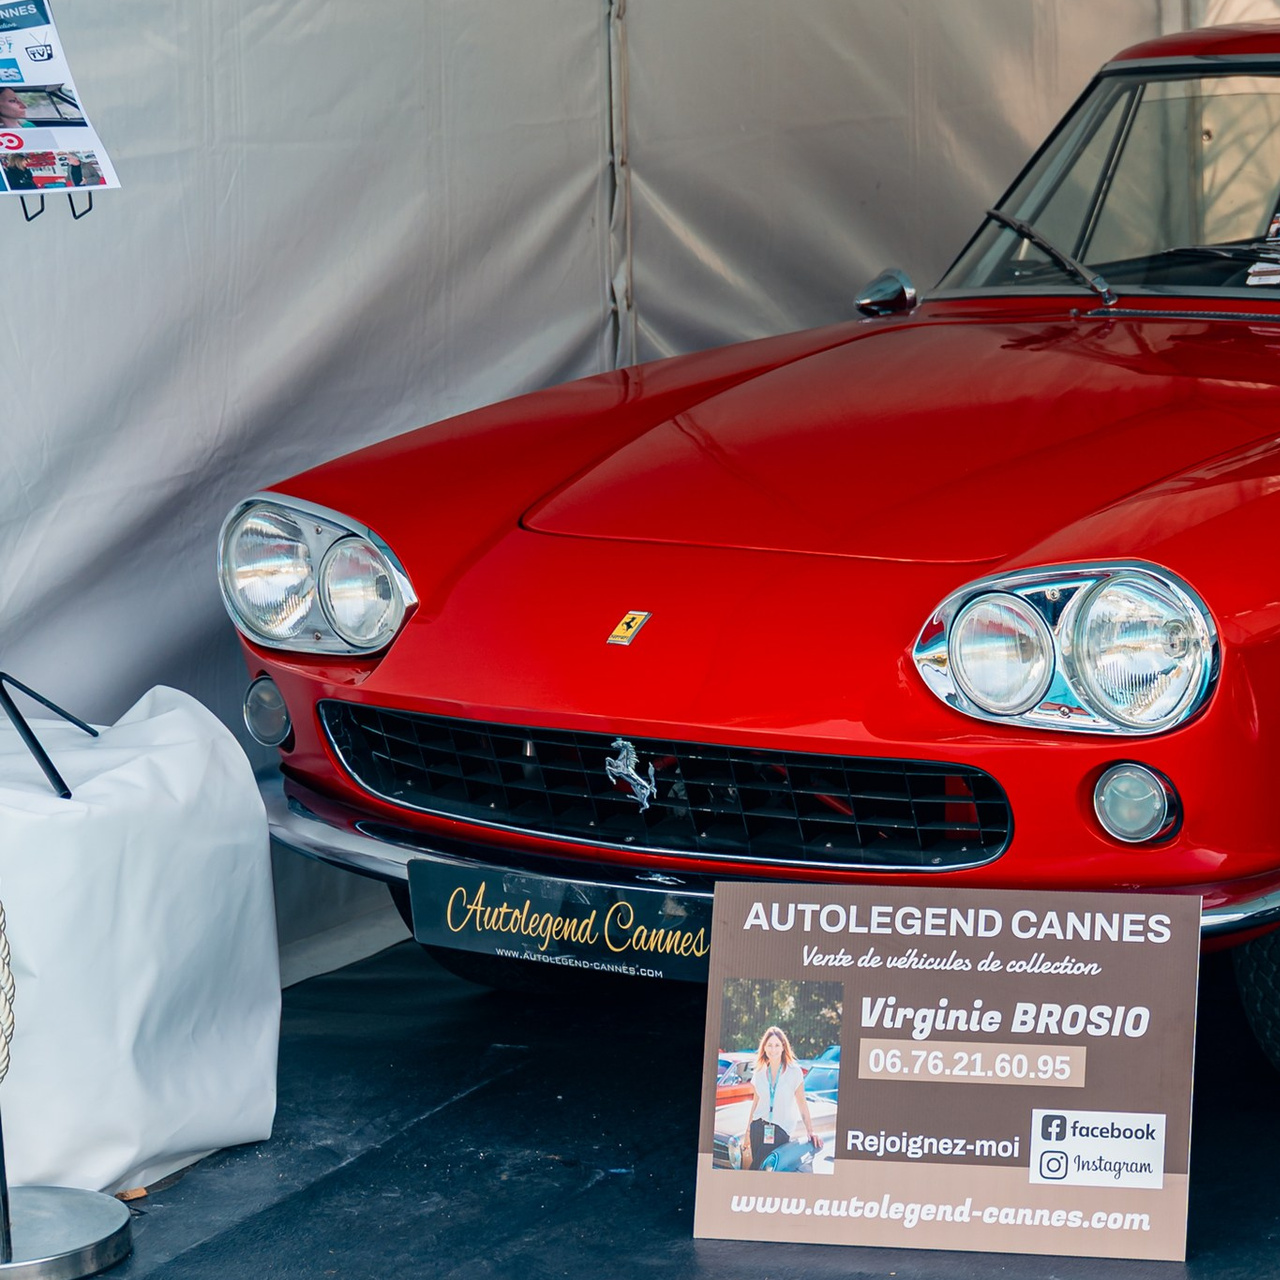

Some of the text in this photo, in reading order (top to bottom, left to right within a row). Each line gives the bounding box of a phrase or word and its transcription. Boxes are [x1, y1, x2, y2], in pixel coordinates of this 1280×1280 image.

[31, 51, 45, 59] TV
[446, 881, 711, 958] Autolegend Cannes
[743, 901, 1171, 943] AUTOLEGEND CANNES
[801, 945, 1102, 977] Vente de véhicules de collection
[860, 996, 1150, 1041] Virginie BROSIO
[868, 1048, 1071, 1080] 06.76.21.60.95
[846, 1130, 1021, 1159] Rejoignez-moi
[1070, 1121, 1157, 1141] facebook
[1073, 1154, 1154, 1180] Instagram
[731, 1193, 1151, 1232] www.autolegend-cannes.com
